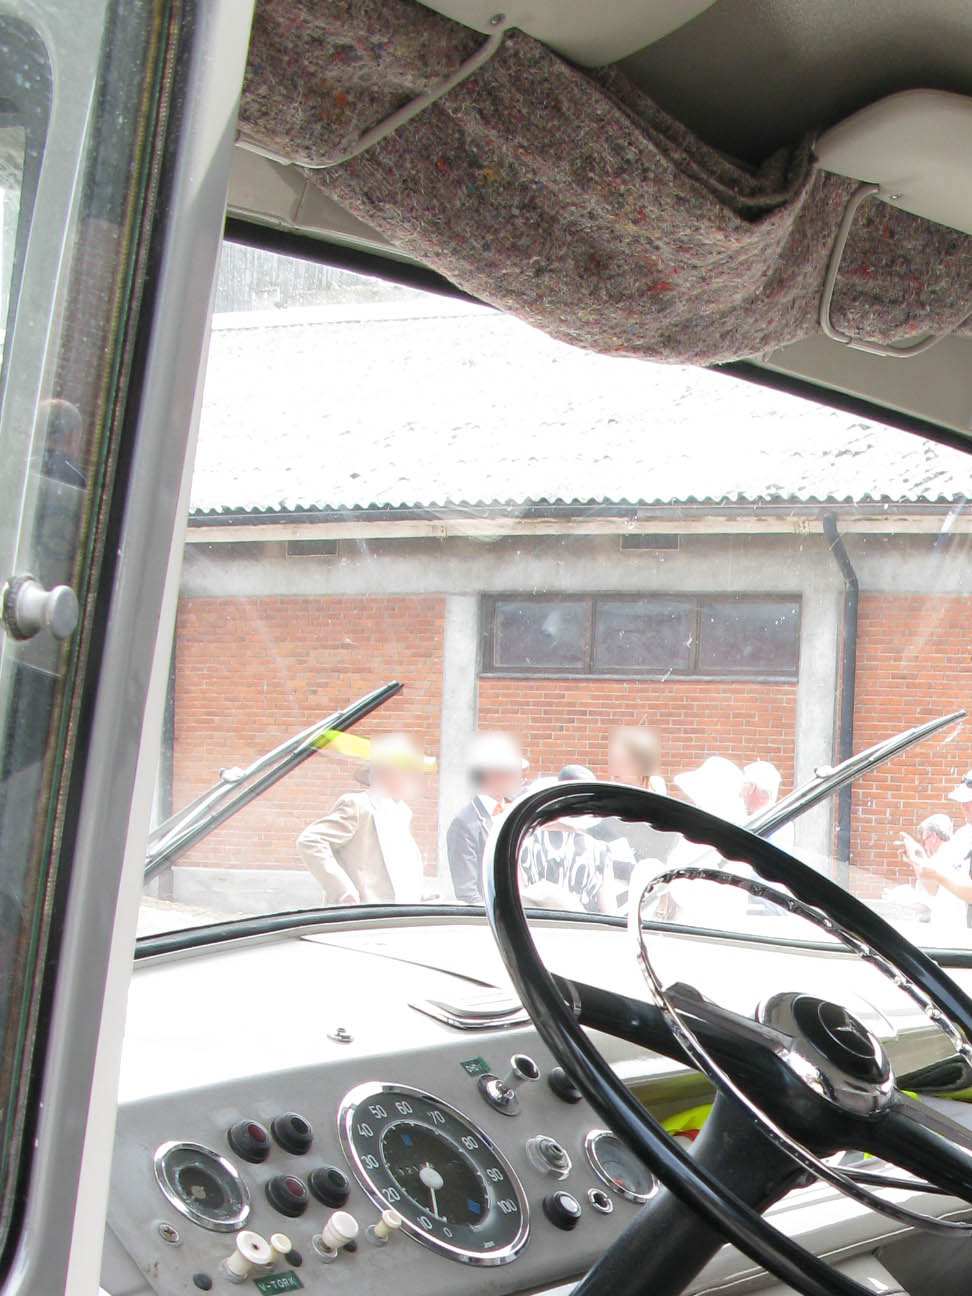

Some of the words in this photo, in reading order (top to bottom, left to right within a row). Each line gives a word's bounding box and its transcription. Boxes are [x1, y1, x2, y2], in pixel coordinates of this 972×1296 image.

[370, 1105, 387, 1119] 50
[395, 1101, 413, 1114] 60
[428, 1110, 445, 1124] 70
[358, 1123, 373, 1137] 40
[461, 1136, 479, 1149] 80
[361, 1155, 379, 1169] 30
[486, 1168, 503, 1182] 90
[384, 1187, 401, 1202] 20
[497, 1200, 517, 1214] 100
[417, 1216, 433, 1231] 10
[443, 1228, 453, 1238] 0
